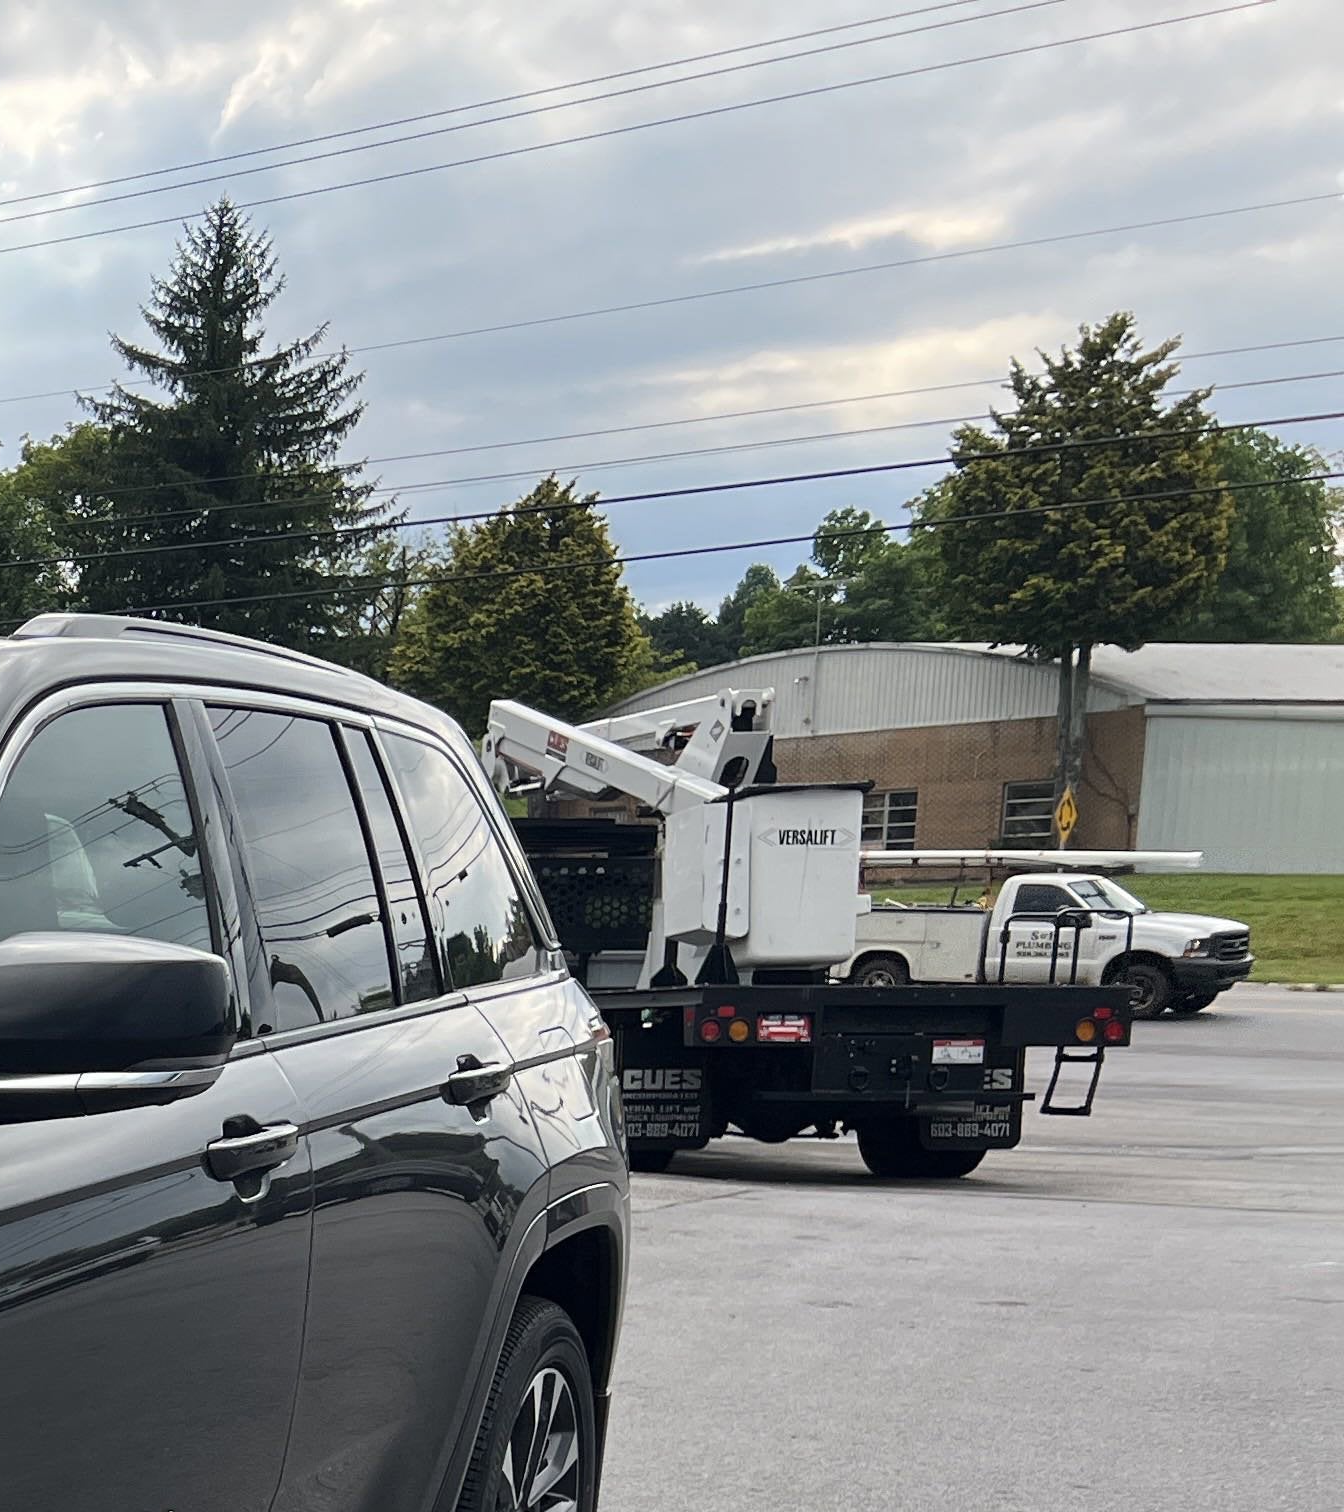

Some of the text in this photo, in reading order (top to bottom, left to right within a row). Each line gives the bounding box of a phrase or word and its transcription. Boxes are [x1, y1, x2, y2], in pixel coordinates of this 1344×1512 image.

[778, 829, 837, 846] VERSALIFT
[1016, 942, 1072, 950] PLUMBNG
[623, 1069, 702, 1090] CUES
[627, 1123, 700, 1137] 03-889-4071
